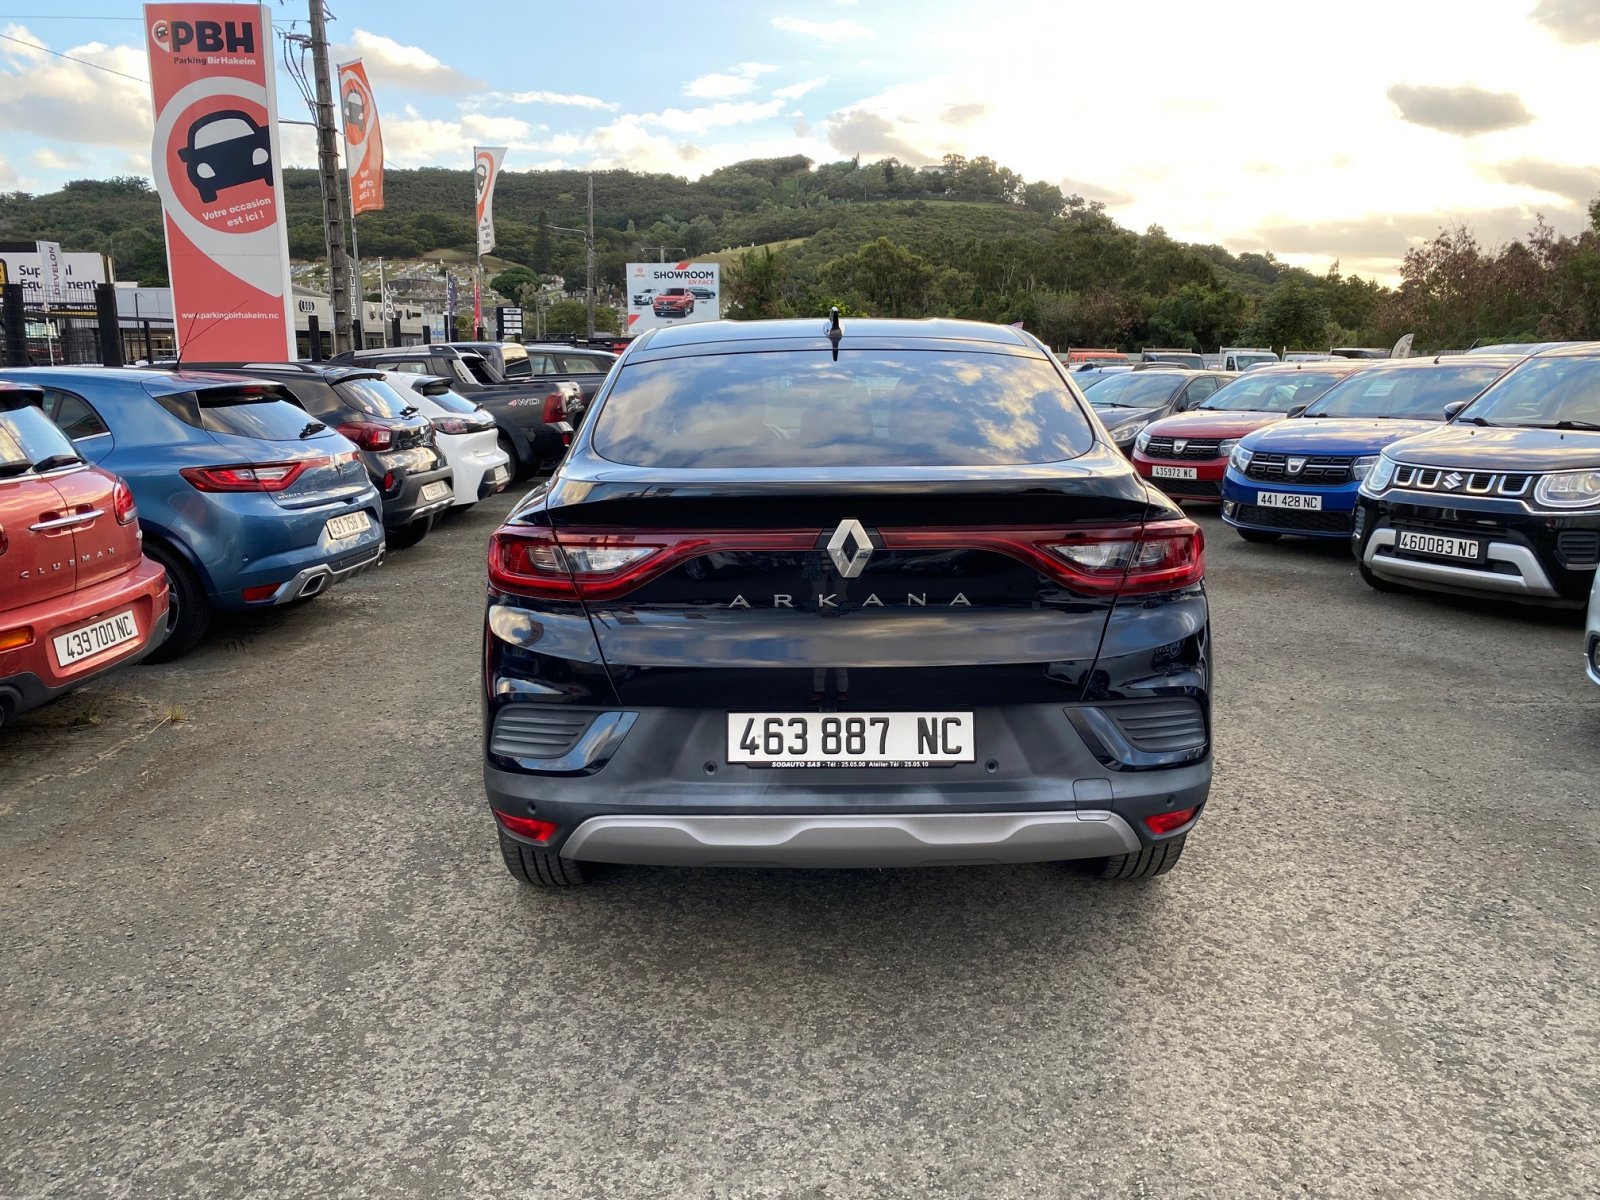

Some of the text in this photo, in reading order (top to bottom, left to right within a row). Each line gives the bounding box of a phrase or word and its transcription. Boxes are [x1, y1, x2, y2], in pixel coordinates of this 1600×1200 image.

[170, 20, 255, 53] PBH
[202, 197, 271, 221] Votre occasion
[227, 216, 244, 227] est
[245, 211, 259, 222] ici
[48, 246, 60, 295] DEVELON
[653, 271, 714, 279] SHOWROOM
[21, 279, 98, 291] Equment
[508, 398, 540, 406] 4WD
[1155, 467, 1180, 477] 435972
[1261, 494, 1317, 508] 441 428 NC
[1401, 534, 1477, 557] 460083 NC
[21, 547, 115, 578] CLUBMAN
[728, 592, 972, 608] ARKANA
[66, 616, 133, 658] 439 700 NC
[740, 717, 962, 755] 463 887 NC
